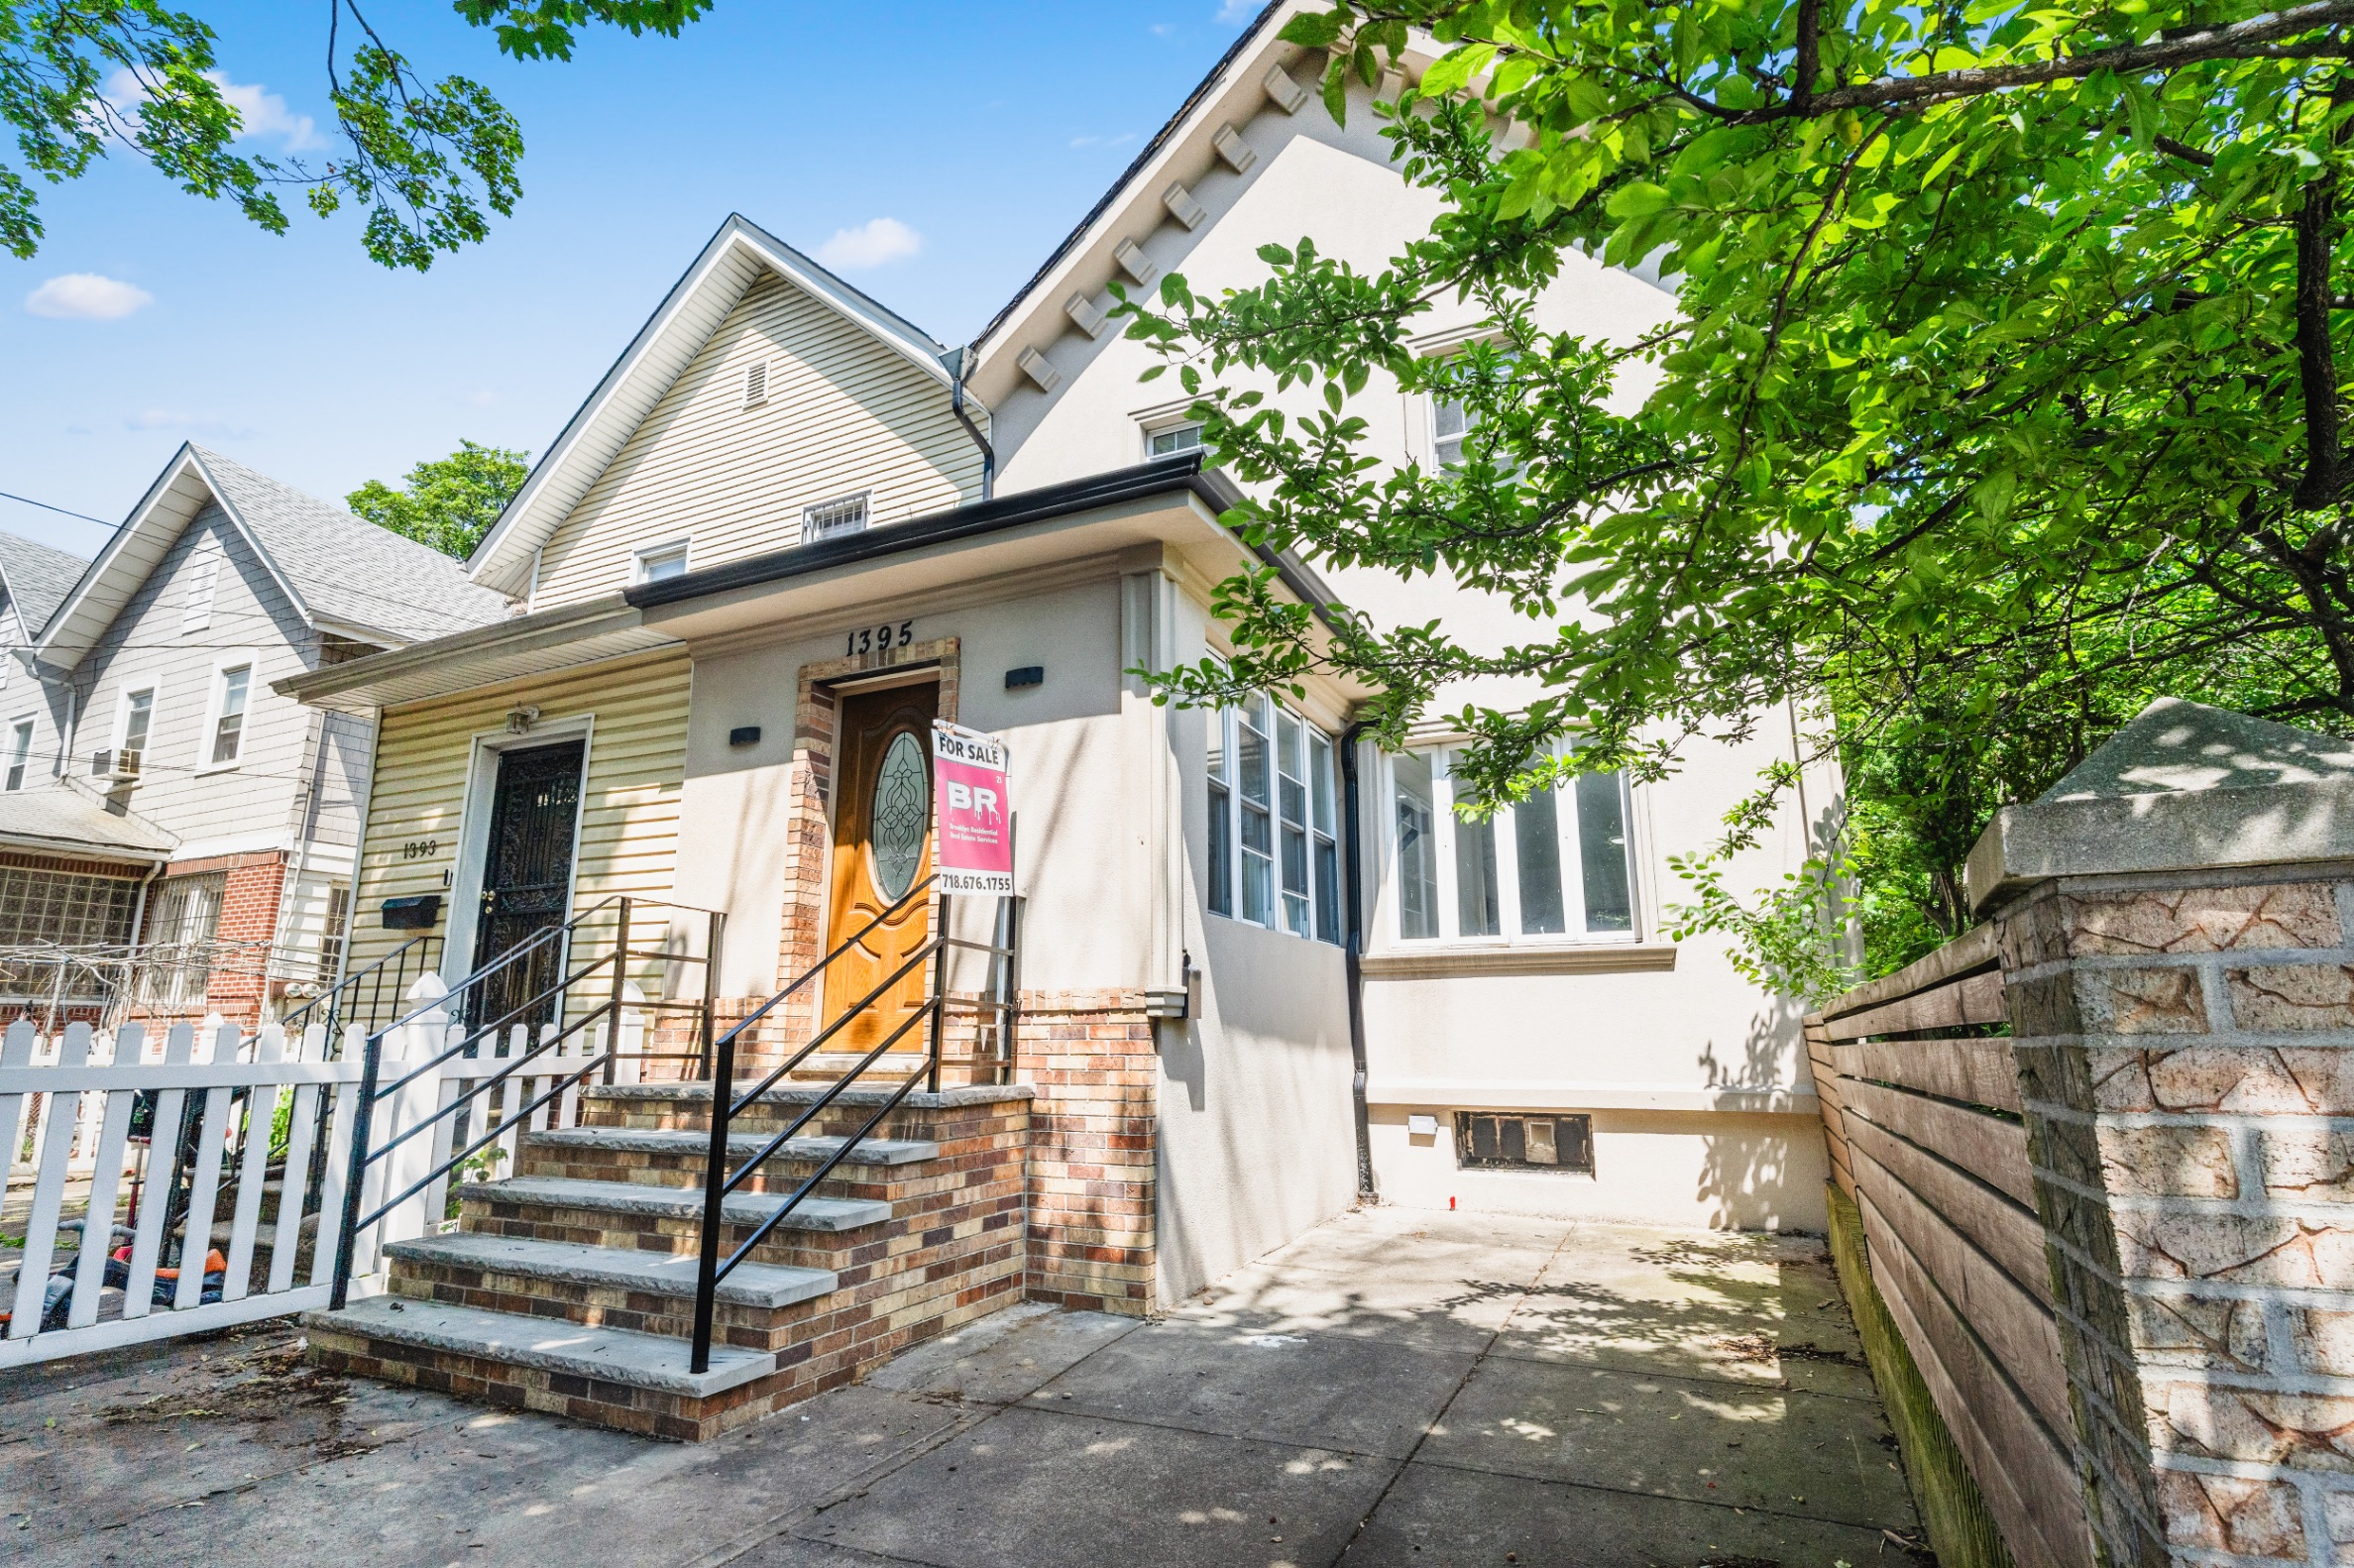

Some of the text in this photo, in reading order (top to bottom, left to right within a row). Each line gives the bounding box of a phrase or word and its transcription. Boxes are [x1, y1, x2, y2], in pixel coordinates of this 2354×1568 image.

[846, 620, 913, 656] 1395
[939, 736, 999, 764] FOR SALE
[948, 780, 1000, 820] BR
[970, 826, 998, 836] Residential
[977, 836, 998, 844] Services
[403, 840, 436, 858] 1393
[942, 874, 1011, 890] 718.676.1755
